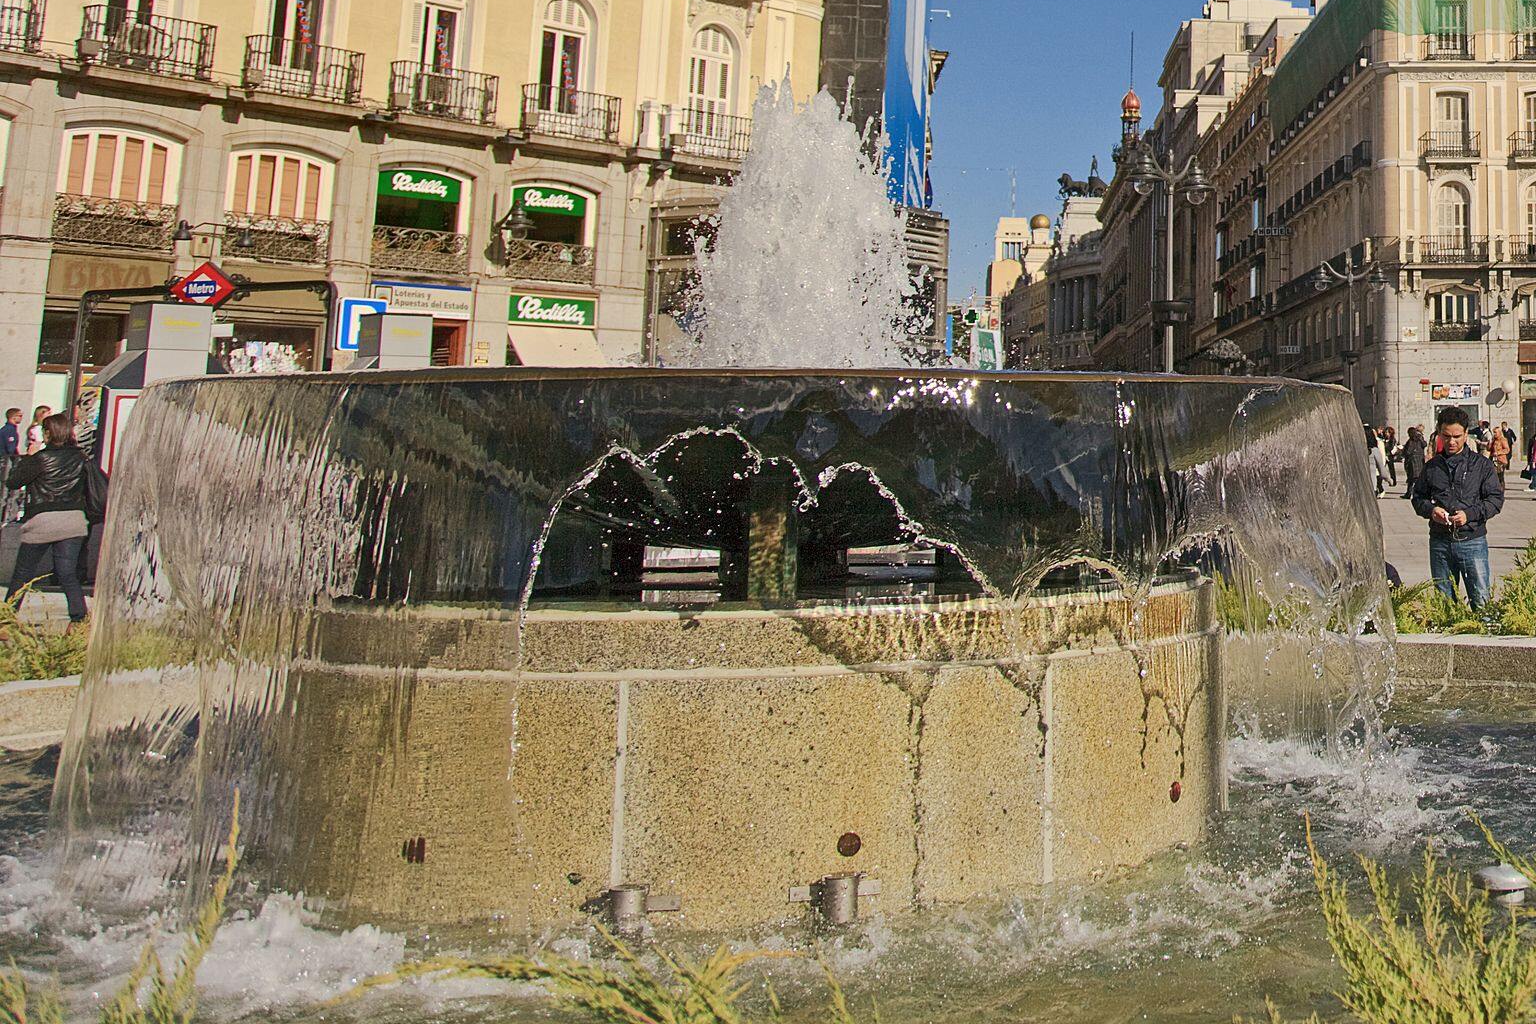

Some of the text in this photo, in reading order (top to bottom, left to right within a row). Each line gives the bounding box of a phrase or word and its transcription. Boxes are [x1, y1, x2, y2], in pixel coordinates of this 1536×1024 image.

[392, 172, 448, 198] Rodilla
[524, 189, 574, 211] Rodilla
[1259, 228, 1291, 236] HOTEL
[187, 281, 216, 295] Metro
[394, 298, 429, 308] Apuestas
[444, 302, 469, 311] Estado
[518, 296, 585, 325] Rodilla
